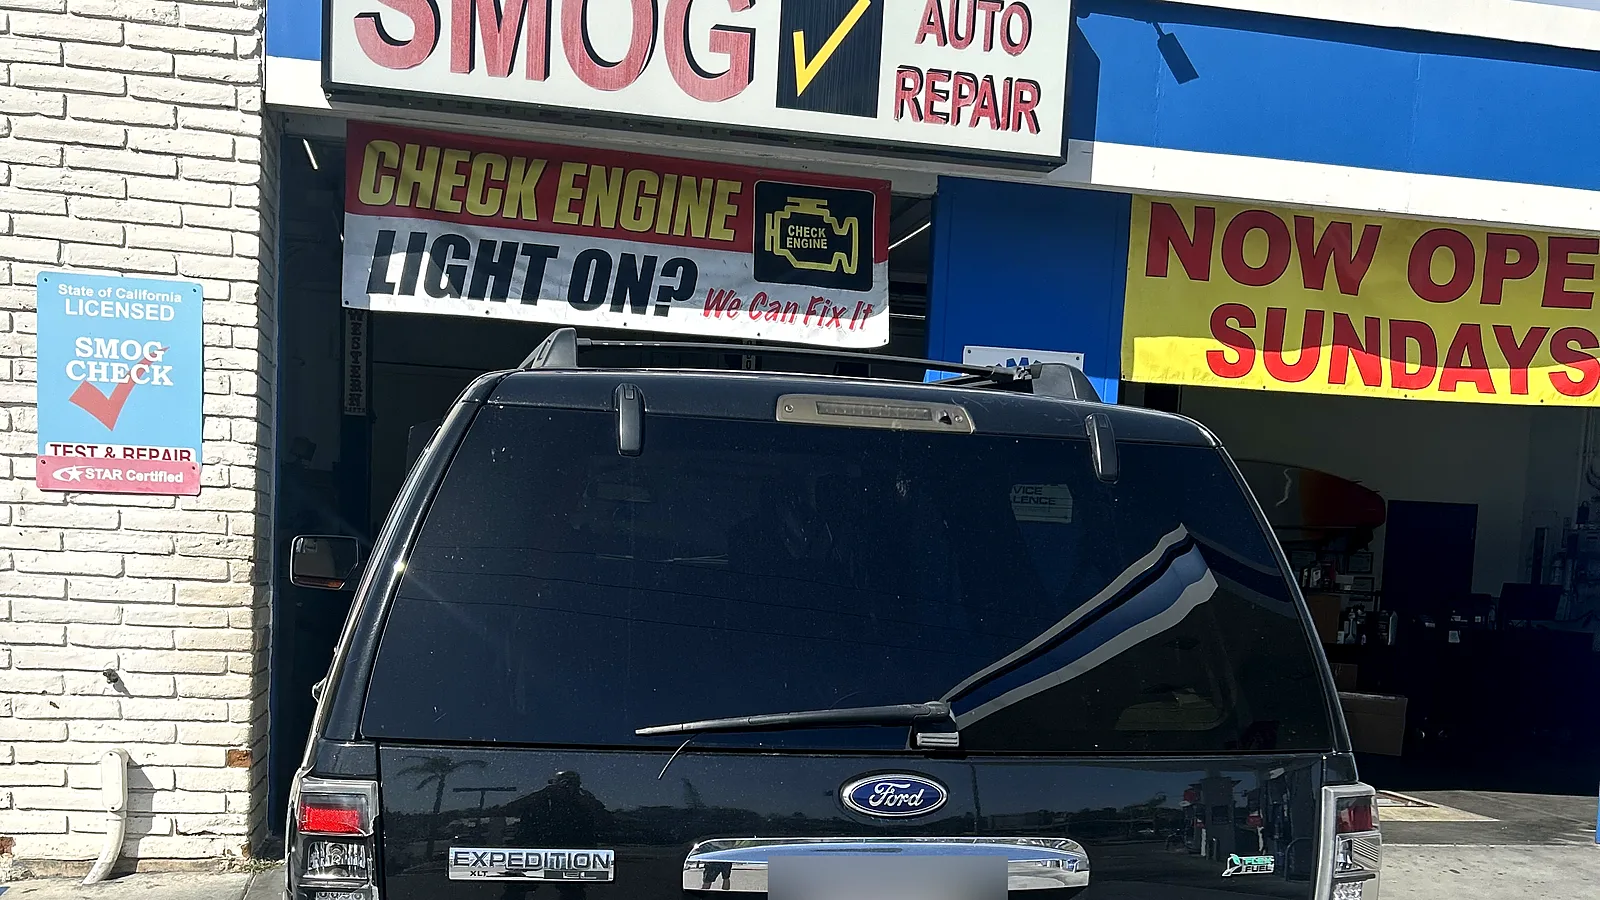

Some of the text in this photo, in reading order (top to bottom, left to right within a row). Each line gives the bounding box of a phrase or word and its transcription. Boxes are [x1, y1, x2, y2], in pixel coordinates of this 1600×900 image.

[915, 0, 1032, 56] AUTO
[894, 65, 1041, 134] REPAIR
[358, 140, 743, 242] CHECK ENGINE
[786, 237, 828, 249] ENGINE
[787, 225, 826, 238] CHECK
[1145, 202, 1600, 309] NOW OPE
[366, 230, 698, 317] LIGHT ON?
[58, 284, 182, 303] State of California
[65, 298, 175, 321] LICENSED
[703, 288, 873, 331] We Can Fix It
[75, 336, 165, 362] SMOG
[1206, 303, 1600, 396] SUNDAYS
[65, 360, 174, 386] CHECK
[85, 468, 183, 483] STAR Certified
[1013, 486, 1043, 496] VICE
[869, 782, 924, 808] Ford
[453, 851, 610, 869] EXPEDITION
[1245, 865, 1273, 873] FUEL
